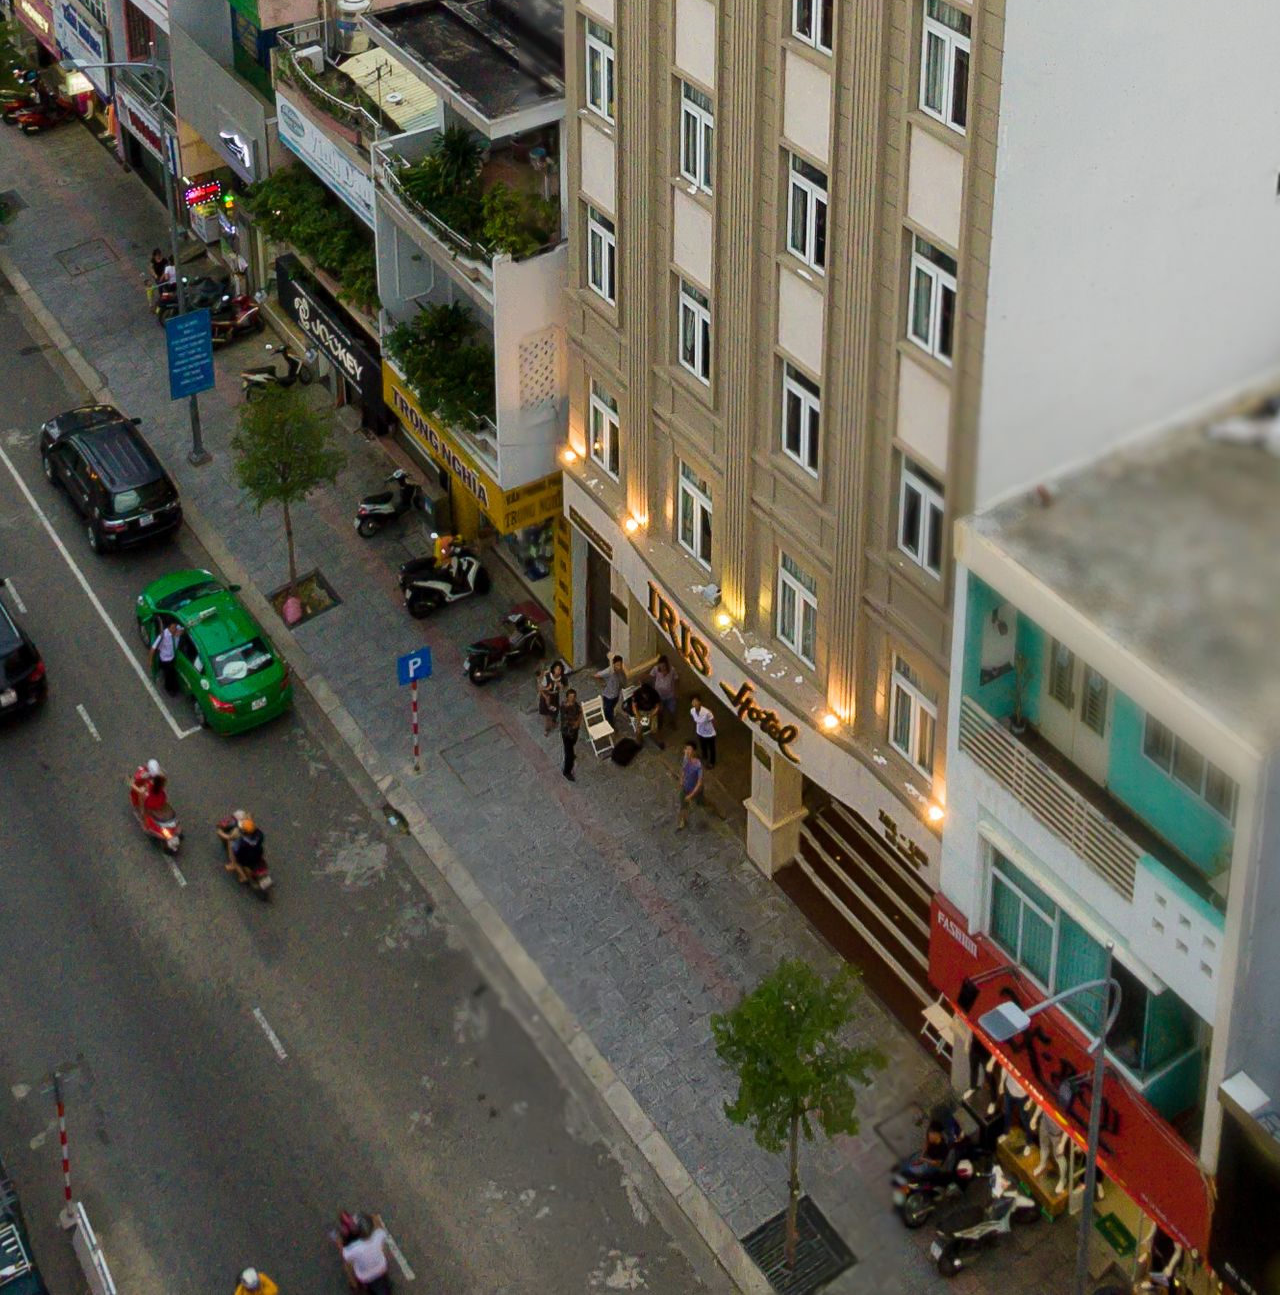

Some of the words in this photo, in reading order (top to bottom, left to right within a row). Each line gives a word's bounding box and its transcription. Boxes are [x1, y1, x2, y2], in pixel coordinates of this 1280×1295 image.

[311, 319, 364, 382] JOCKEY
[408, 657, 422, 678] P
[648, 580, 712, 678] IRIS
[719, 682, 800, 764] Hotel
